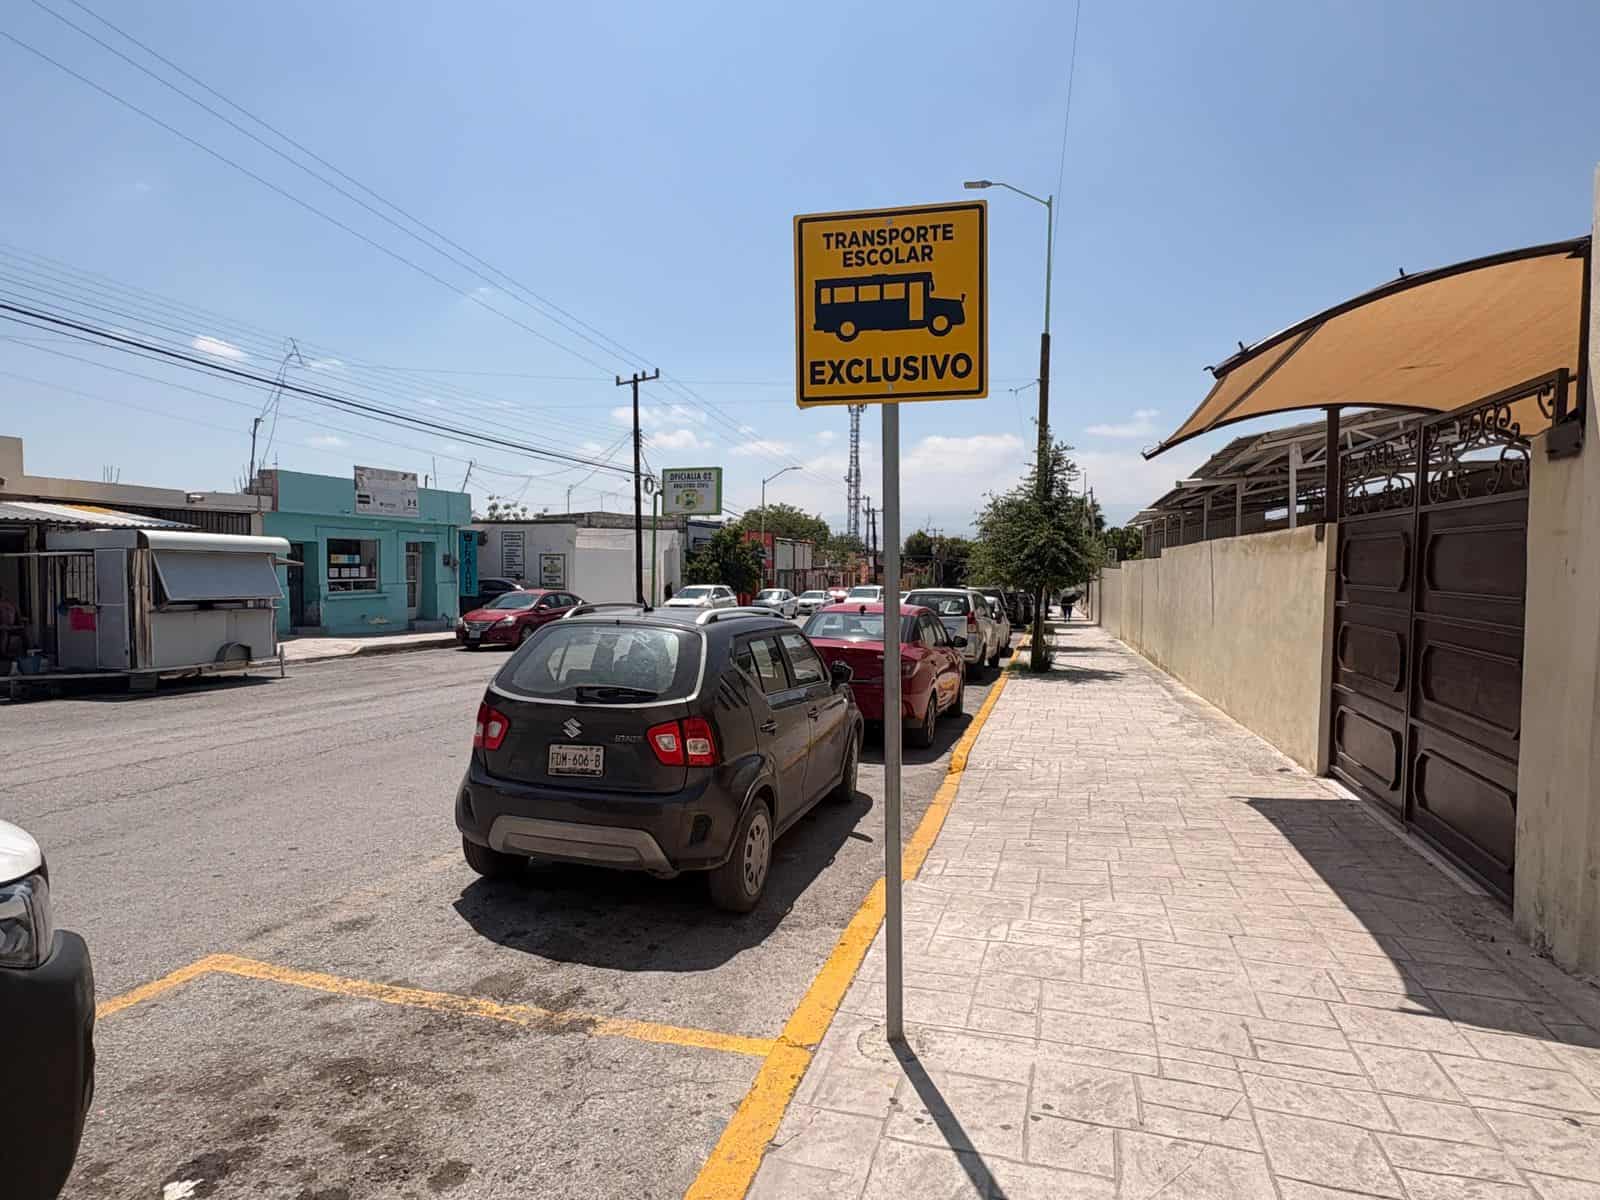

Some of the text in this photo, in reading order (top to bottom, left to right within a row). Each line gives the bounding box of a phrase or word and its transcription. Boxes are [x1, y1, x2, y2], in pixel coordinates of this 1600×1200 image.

[822, 223, 954, 250] TRANSPORTE
[842, 245, 934, 268] ESCOLAR
[809, 352, 973, 386] EXCLUSIVO
[551, 752, 600, 769] FDM-606-B
